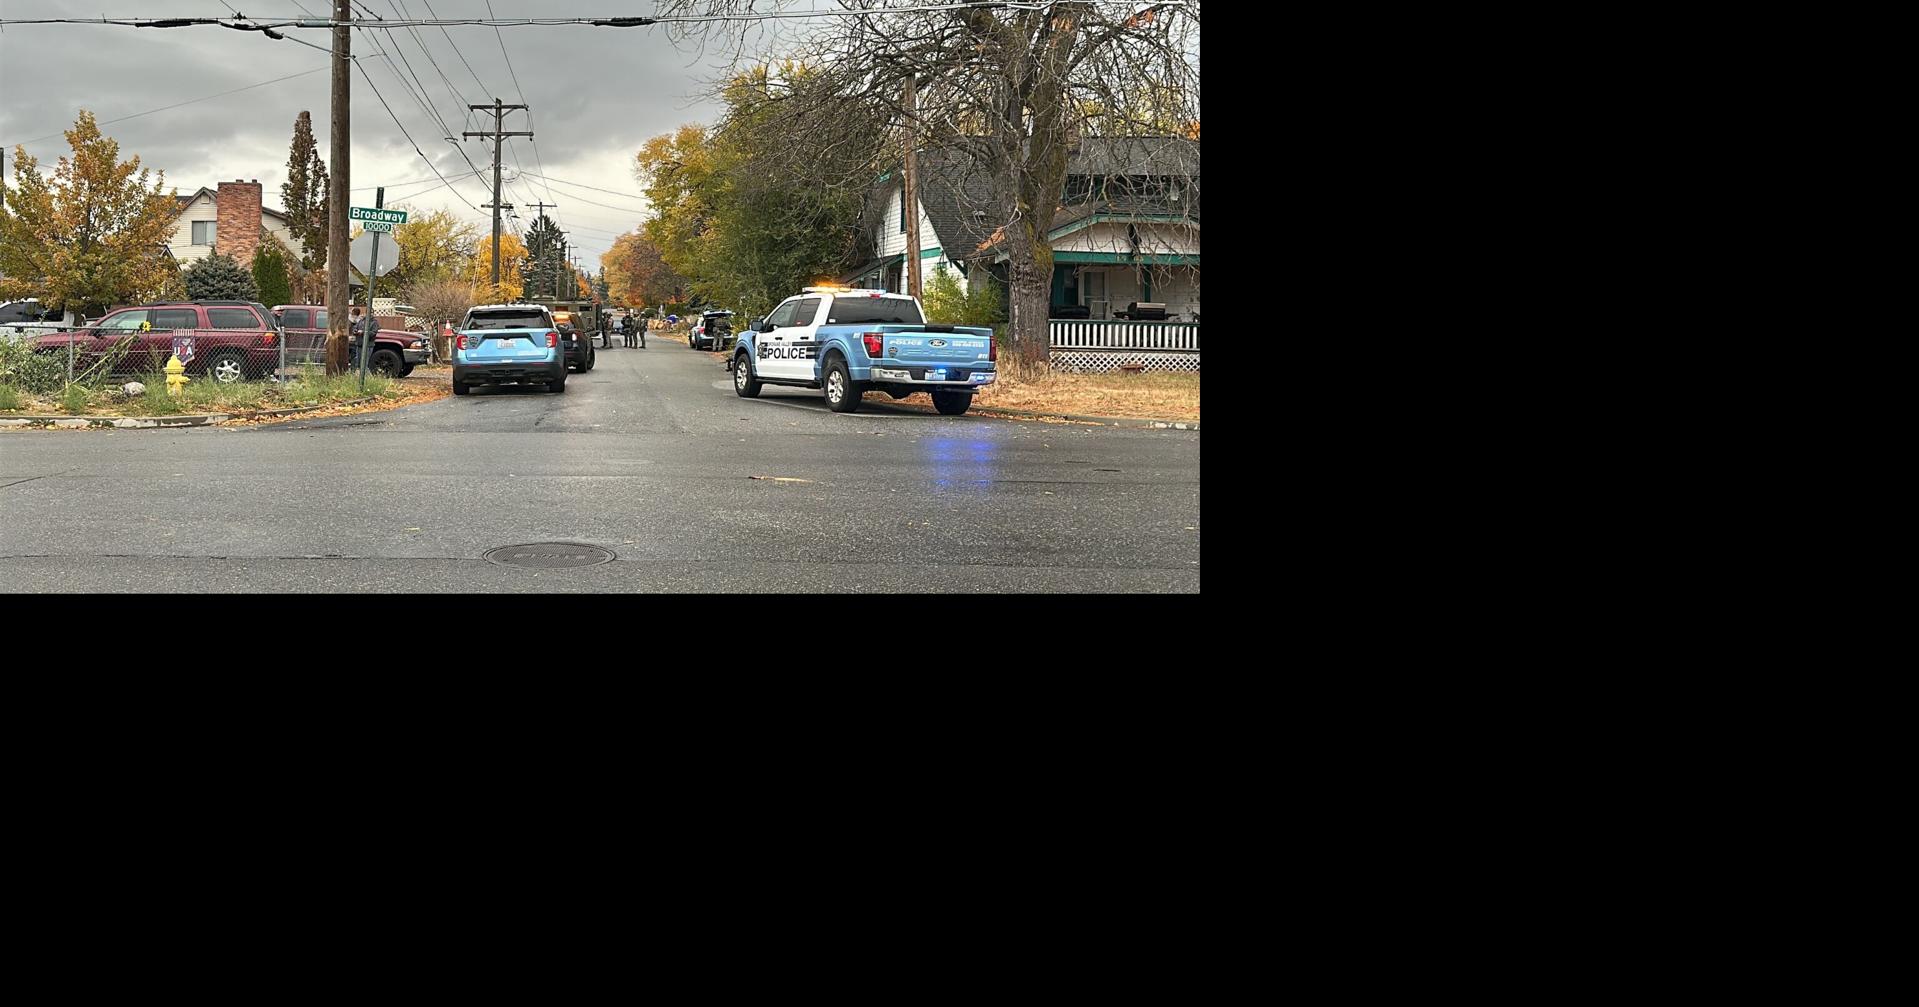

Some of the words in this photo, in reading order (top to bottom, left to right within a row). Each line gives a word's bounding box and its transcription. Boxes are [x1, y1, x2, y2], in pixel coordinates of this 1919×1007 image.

[352, 208, 404, 223] Broadway
[365, 222, 390, 231] 10000
[767, 347, 806, 360] POLICE
